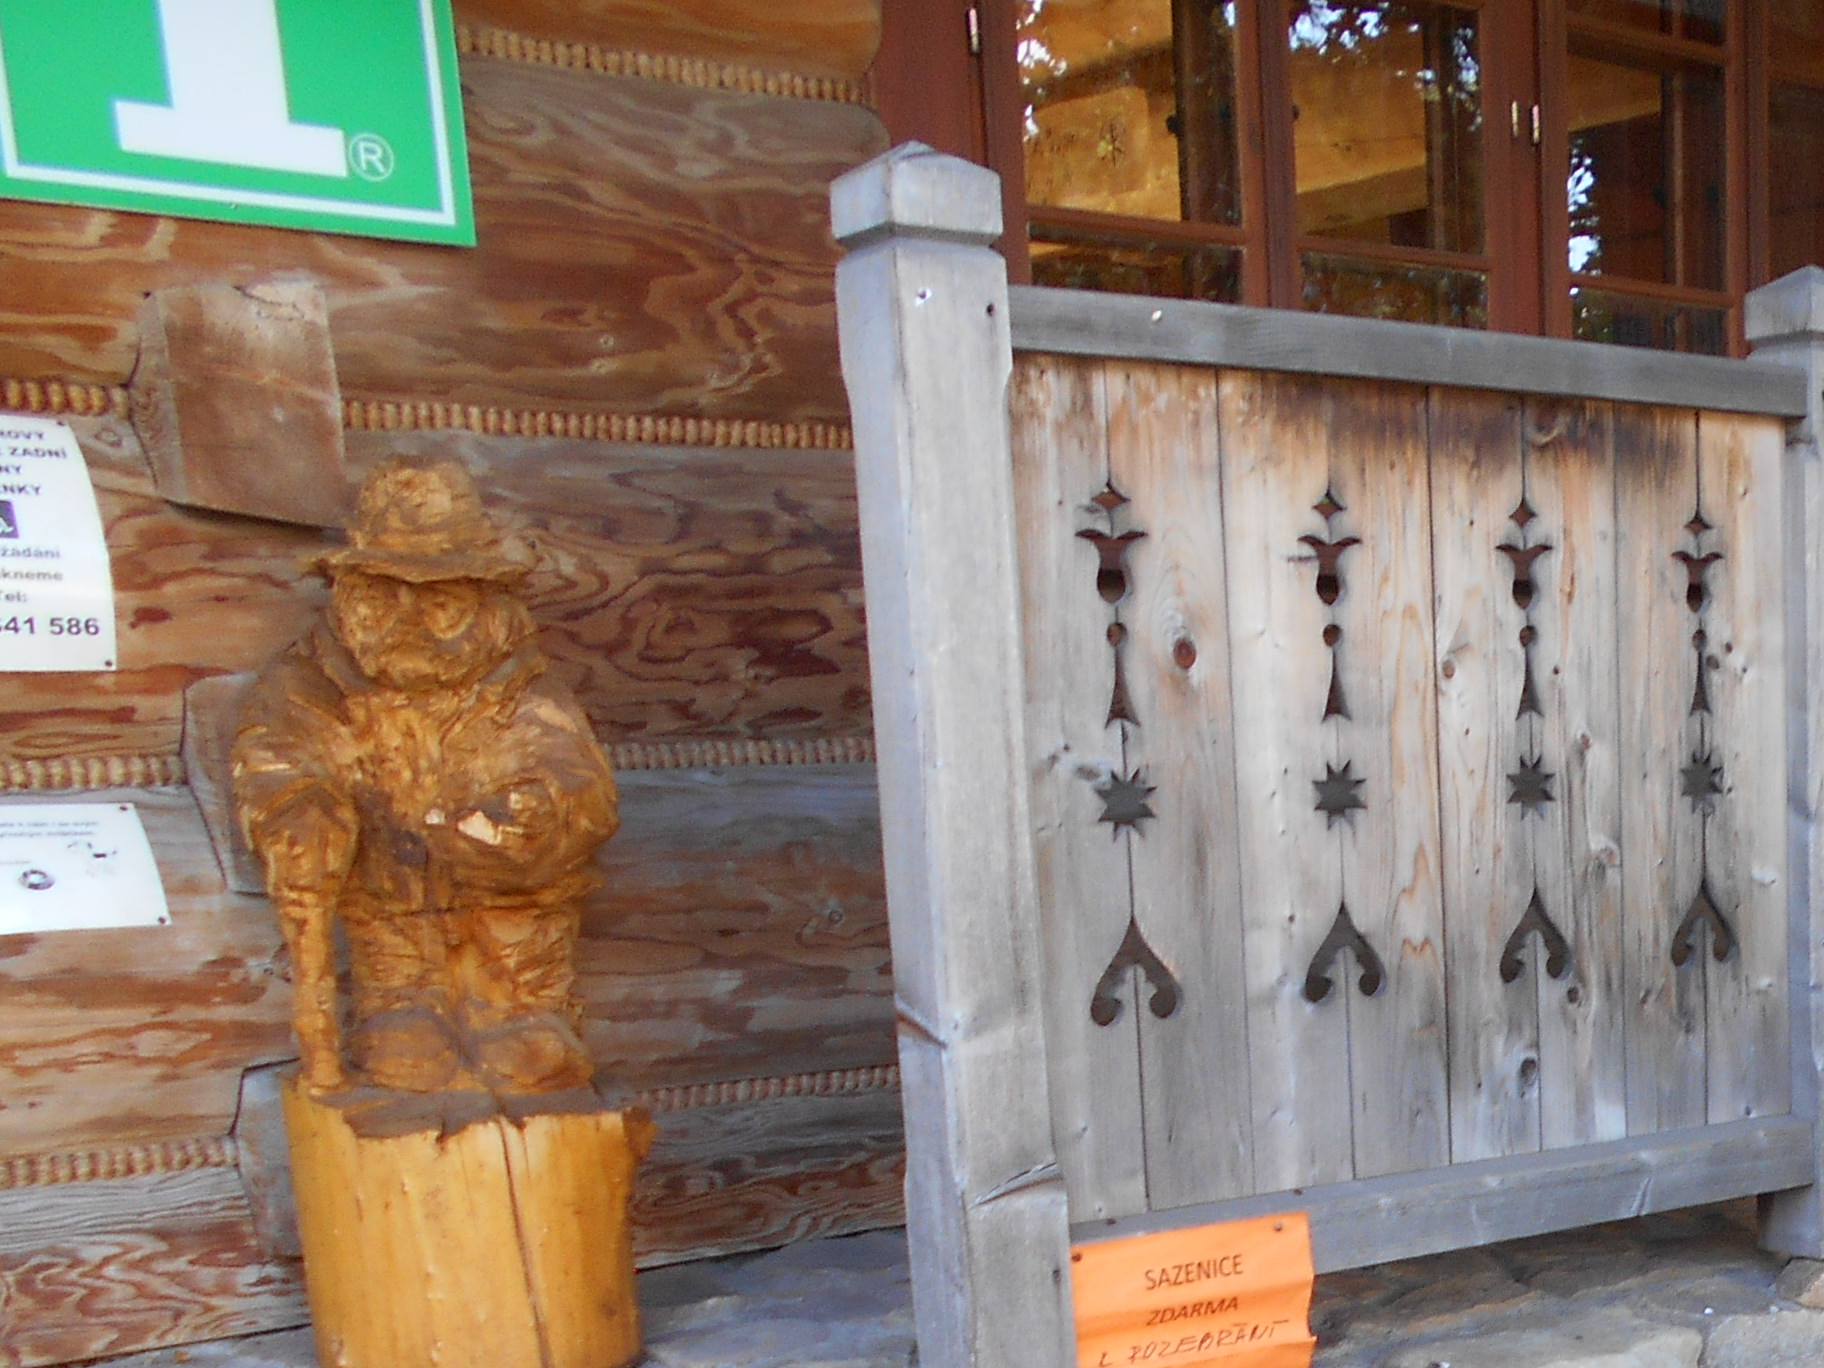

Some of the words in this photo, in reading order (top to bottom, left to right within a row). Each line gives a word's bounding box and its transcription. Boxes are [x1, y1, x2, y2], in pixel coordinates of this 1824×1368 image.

[50, 617, 100, 635] 586
[1144, 1254, 1243, 1290] SAZENICE
[1146, 1296, 1239, 1326] ZDARMA
